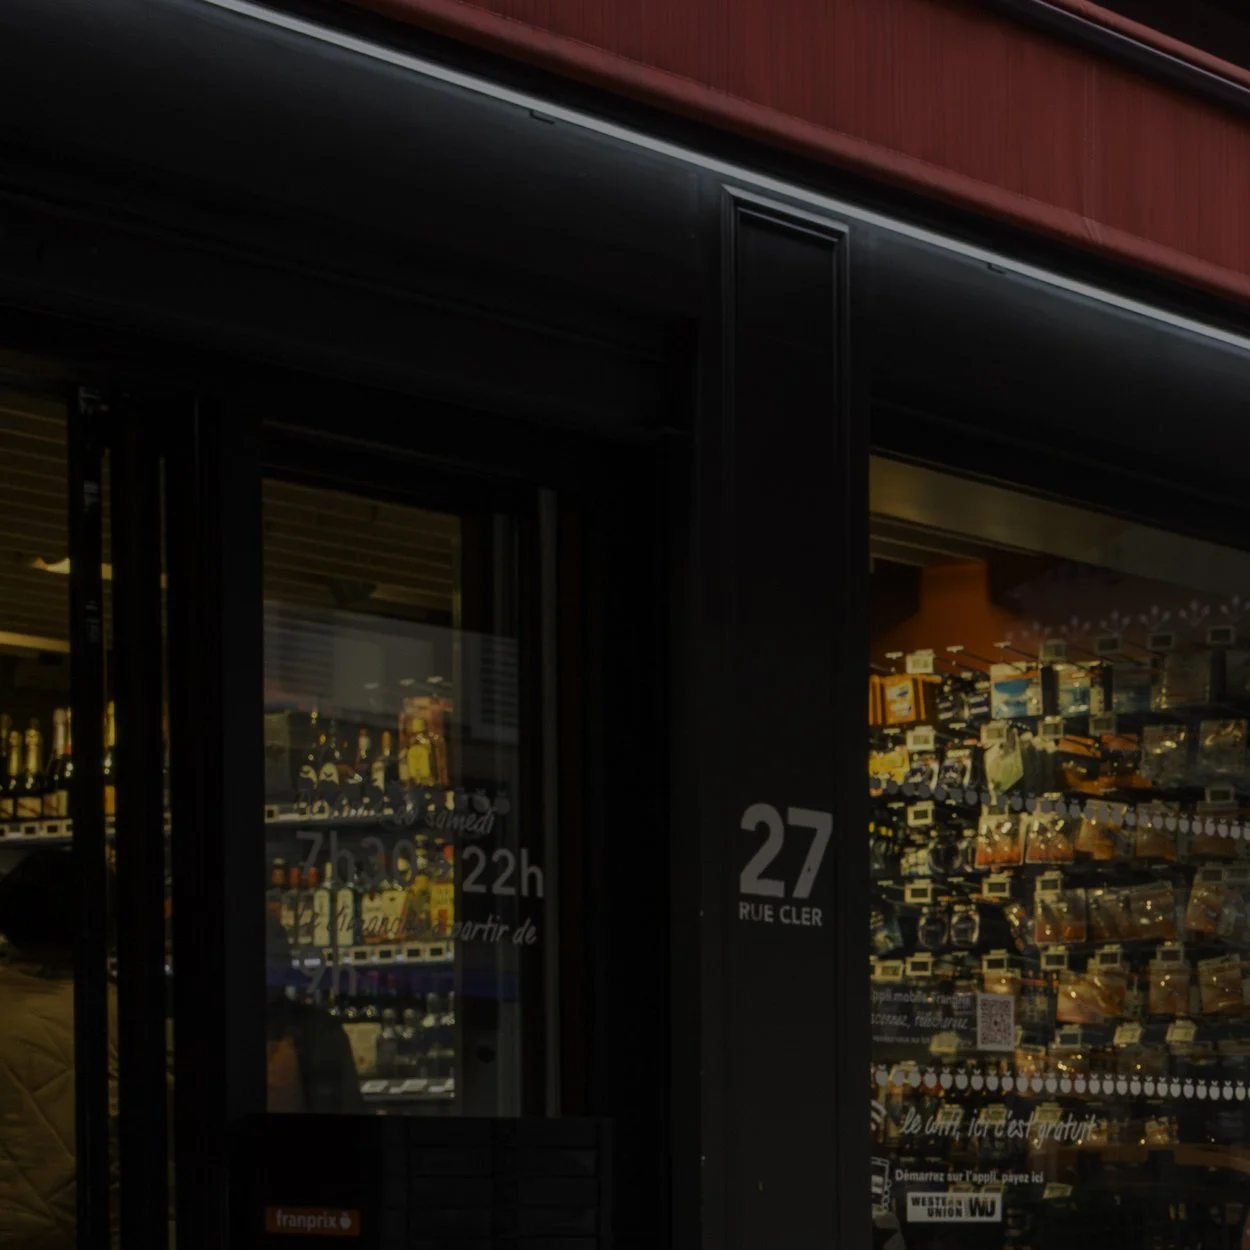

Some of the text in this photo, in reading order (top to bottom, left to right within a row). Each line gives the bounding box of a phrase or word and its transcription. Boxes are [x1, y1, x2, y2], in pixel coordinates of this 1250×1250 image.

[740, 802, 834, 899] 27
[296, 829, 417, 884] 7h30
[461, 845, 544, 899] 22h
[738, 901, 823, 927] RUE CLER
[513, 917, 537, 945] de
[1034, 1113, 1097, 1150] gratuit
[895, 1168, 945, 1182] Démarrez
[947, 1171, 964, 1182] sur
[1002, 1171, 1029, 1185] payez
[1031, 1170, 1044, 1183] ici
[911, 1196, 996, 1217] WESTERN WU
[927, 1207, 962, 1218] UNION
[276, 1208, 337, 1232] franprix
